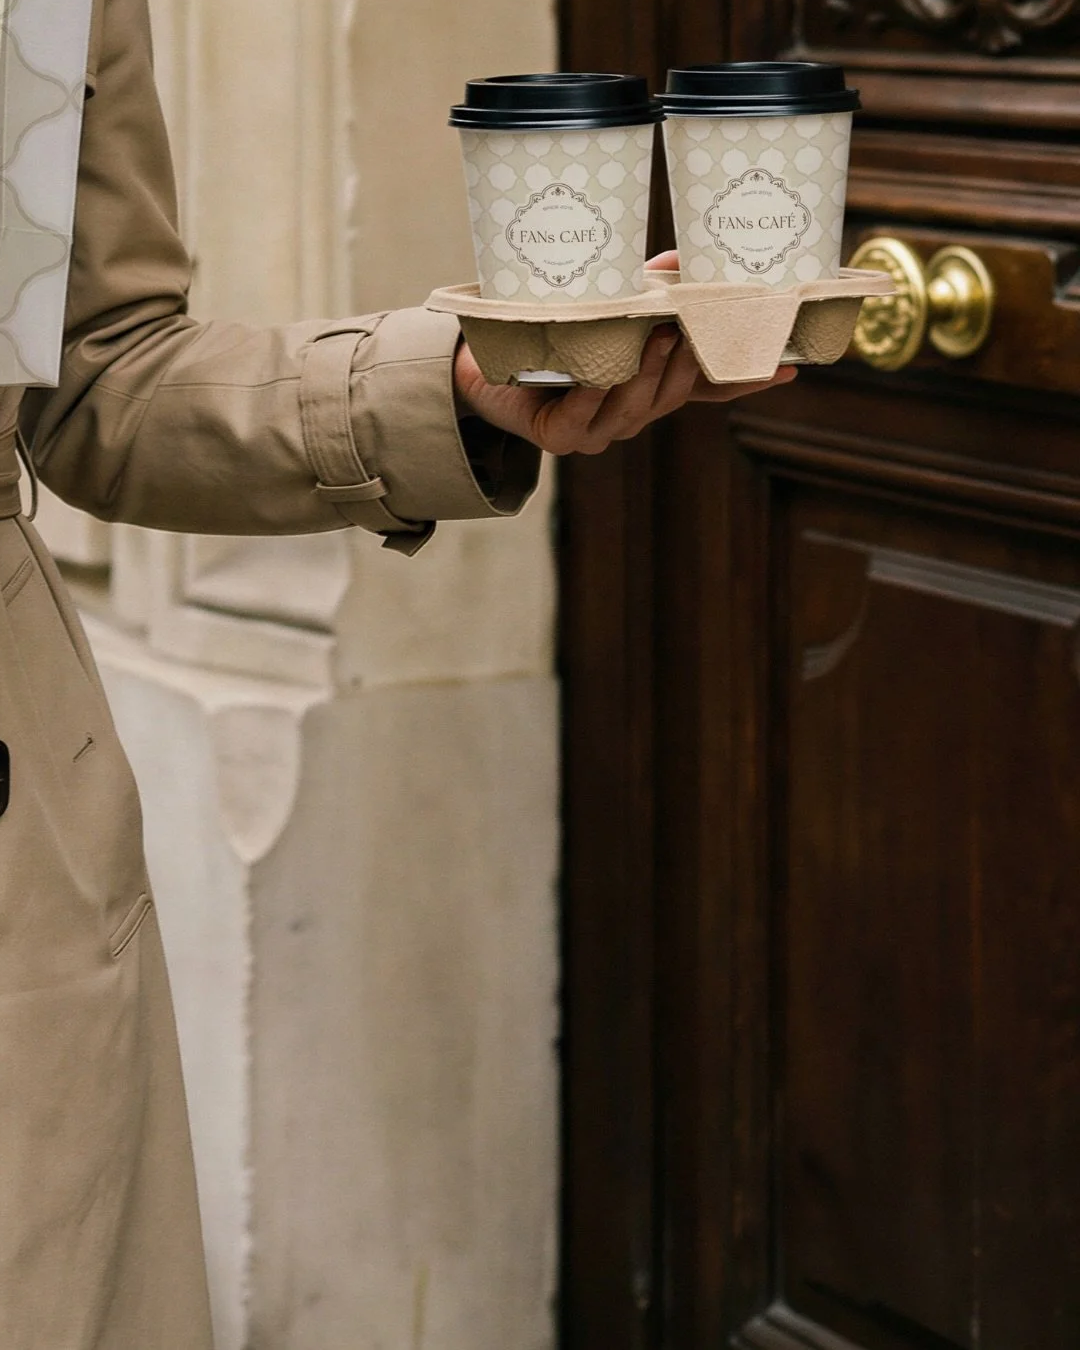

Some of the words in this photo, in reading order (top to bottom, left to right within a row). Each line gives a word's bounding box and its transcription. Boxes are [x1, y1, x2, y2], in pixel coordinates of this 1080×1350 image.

[718, 216, 754, 230] FANs
[758, 211, 797, 230] CAFÉ
[520, 230, 555, 243] FANs
[560, 226, 597, 243] CAFÉ
